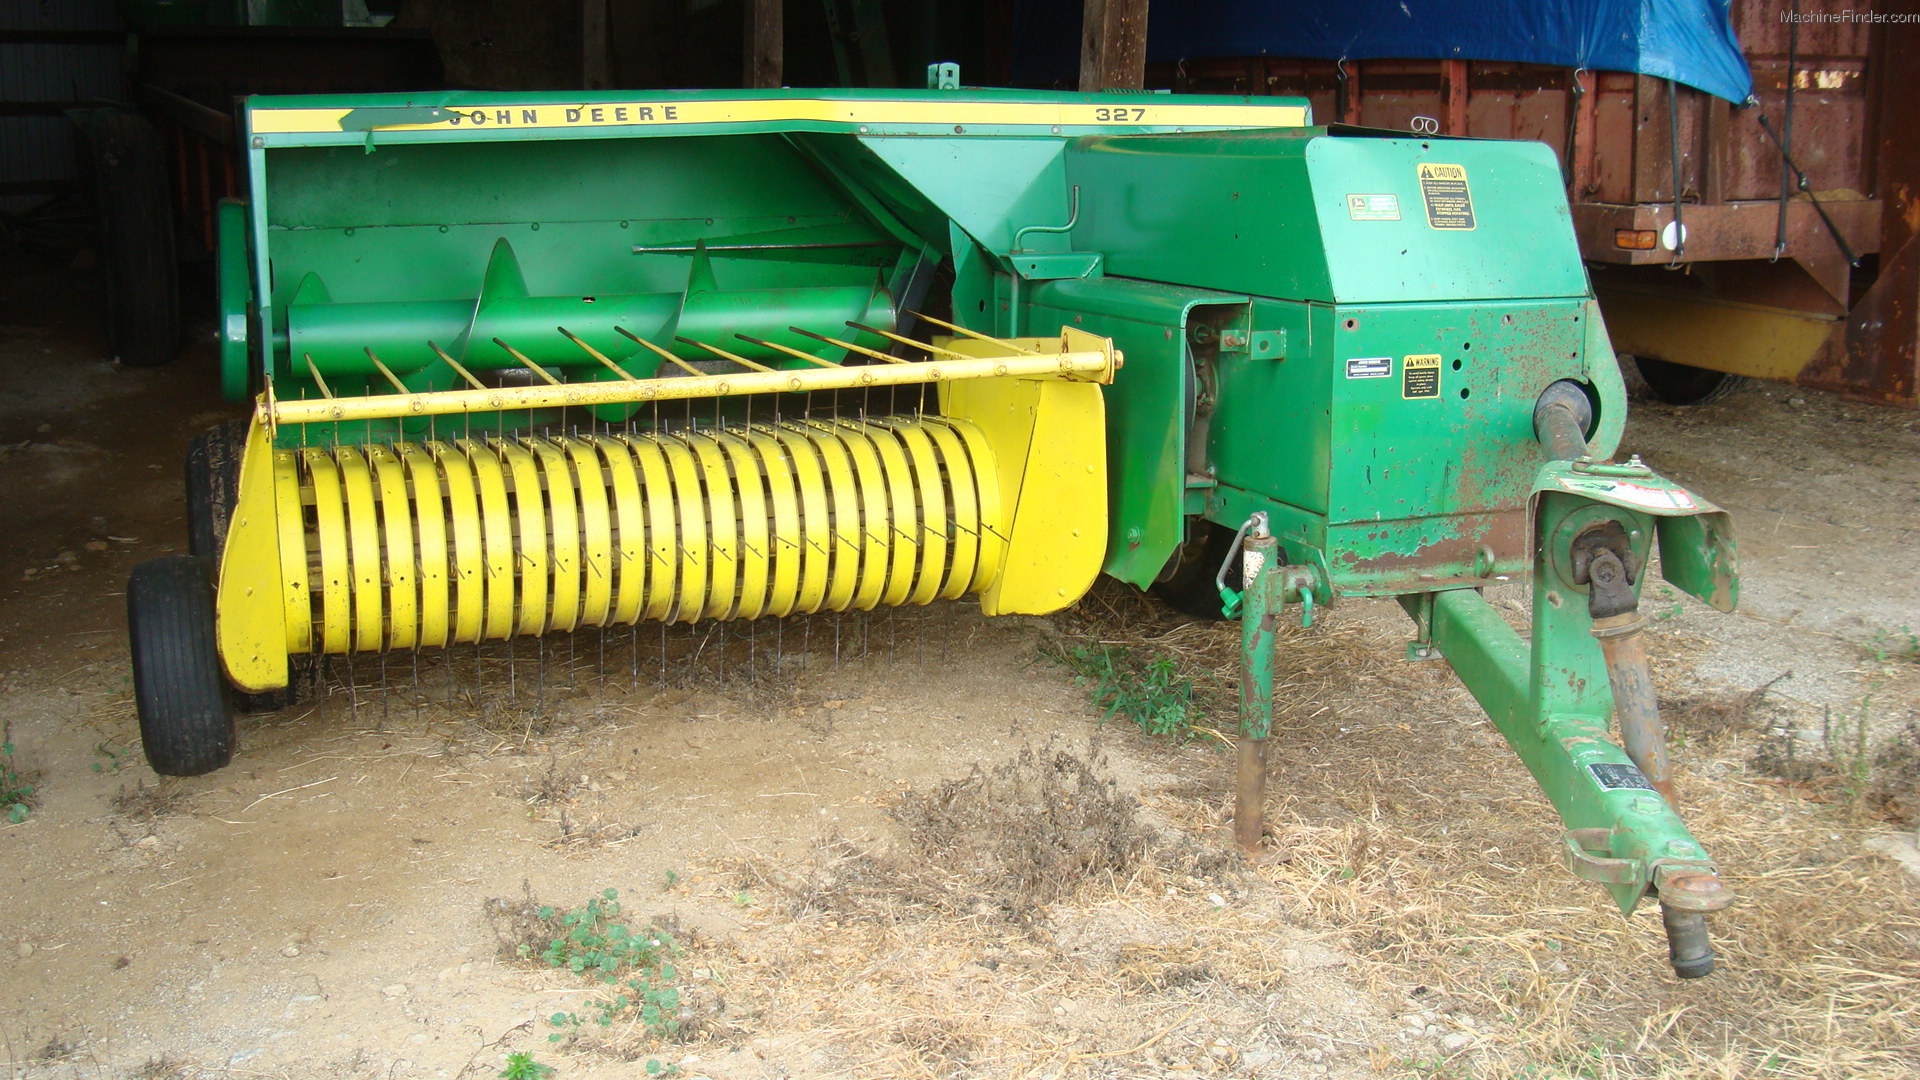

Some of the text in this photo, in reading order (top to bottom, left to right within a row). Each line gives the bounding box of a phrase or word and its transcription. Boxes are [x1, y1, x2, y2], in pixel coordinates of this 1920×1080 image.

[566, 106, 678, 122] DEERE
[1095, 108, 1146, 122] 327
[1434, 166, 1463, 179] CAUTION
[1415, 357, 1440, 367] WARNING
